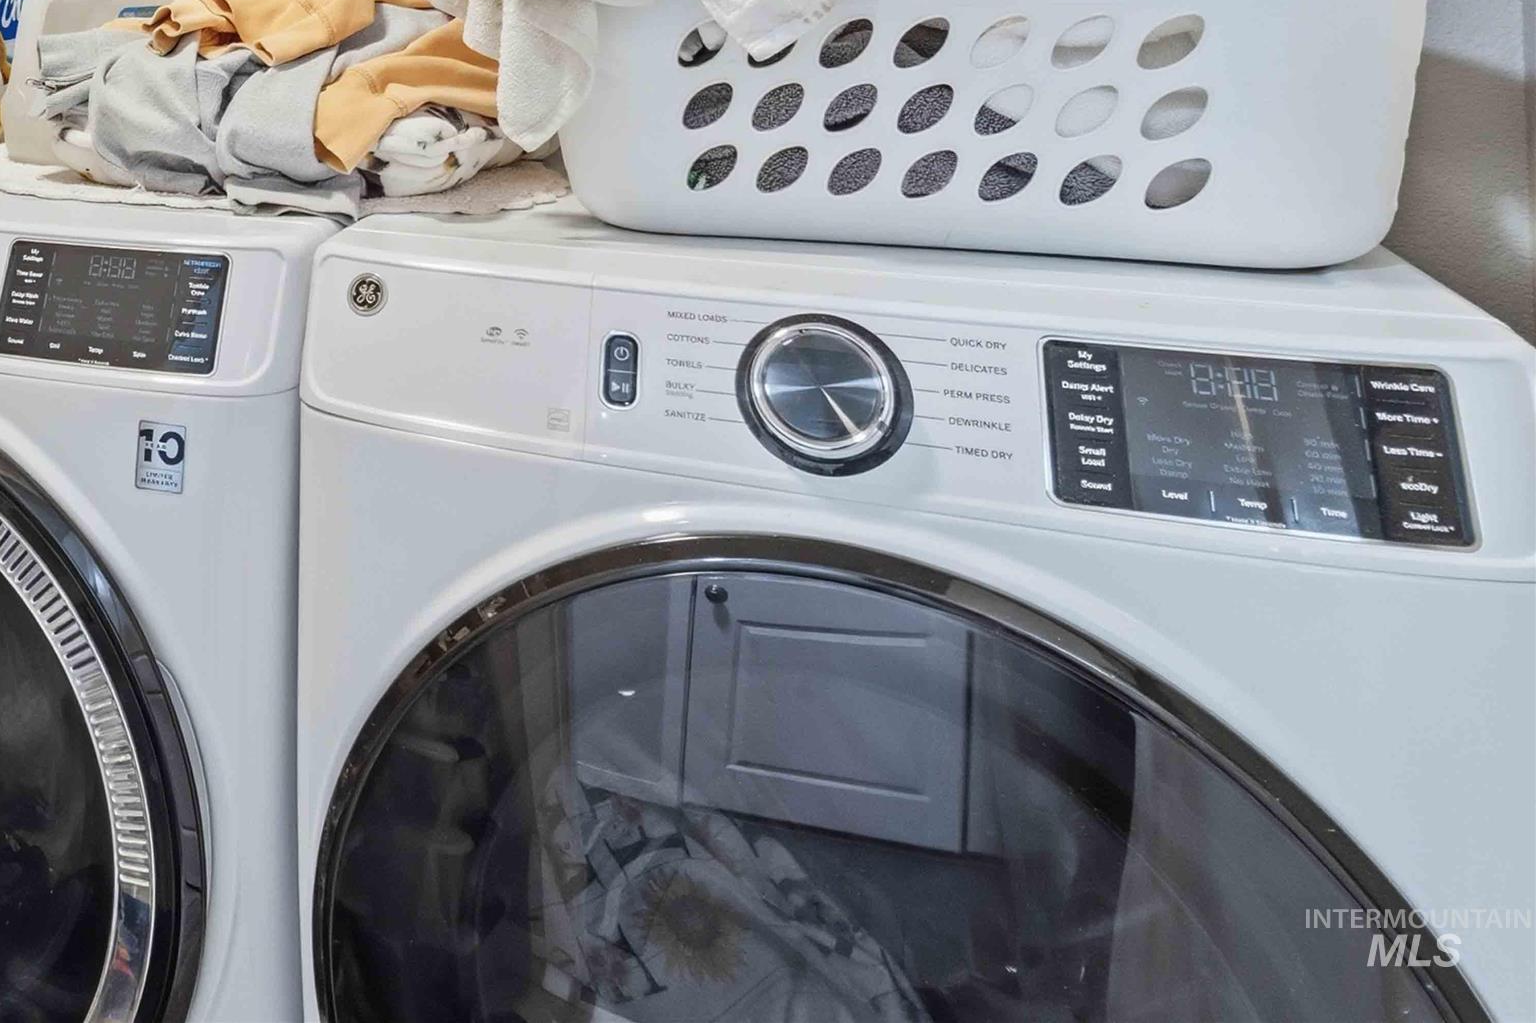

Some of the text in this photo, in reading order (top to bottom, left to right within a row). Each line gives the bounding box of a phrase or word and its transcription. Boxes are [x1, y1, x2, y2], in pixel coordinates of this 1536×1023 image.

[667, 311, 728, 324] MIXED LOADS
[667, 333, 710, 345] COTTONS
[949, 337, 1007, 351] QUICK DRY
[1078, 350, 1092, 361] My
[666, 358, 703, 370] TOWELS
[950, 362, 1007, 376] DELICATES
[1067, 360, 1107, 372] Settings
[665, 382, 695, 391] BULKY
[1370, 380, 1436, 394] Wrinkle Care
[943, 389, 1011, 405] PERM PRESS
[664, 410, 706, 422] SANITIZE
[1096, 415, 1114, 426] Dry
[1375, 412, 1431, 425] More Time
[948, 417, 1011, 432] DEWRINKLE
[139, 429, 185, 466] 10
[955, 446, 1013, 461] TIMED DRY
[1078, 446, 1106, 457] Small
[1382, 445, 1435, 458] Less Time
[1081, 457, 1105, 467] Load
[1162, 489, 1189, 501] Level
[1237, 498, 1268, 511] Temp
[1320, 507, 1347, 519] Time
[1410, 511, 1439, 524] Light
